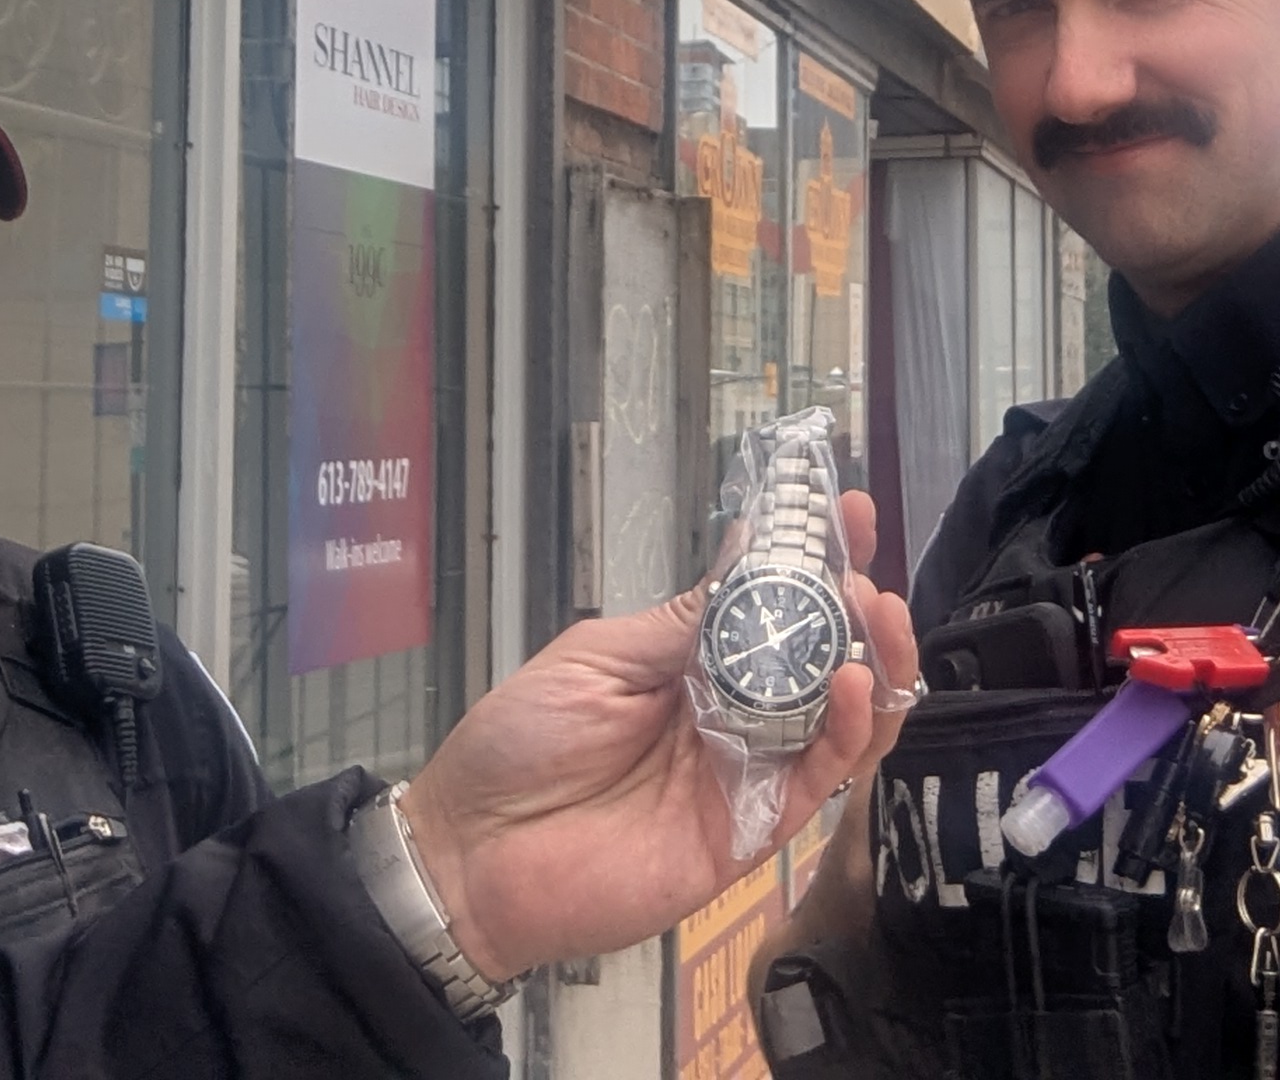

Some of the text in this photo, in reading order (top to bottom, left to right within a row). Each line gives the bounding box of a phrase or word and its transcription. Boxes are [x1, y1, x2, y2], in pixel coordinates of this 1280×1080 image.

[353, 84, 420, 122] HAIR DESIGN
[318, 457, 410, 506] 613-789-4147
[876, 758, 1167, 909] POLIE
